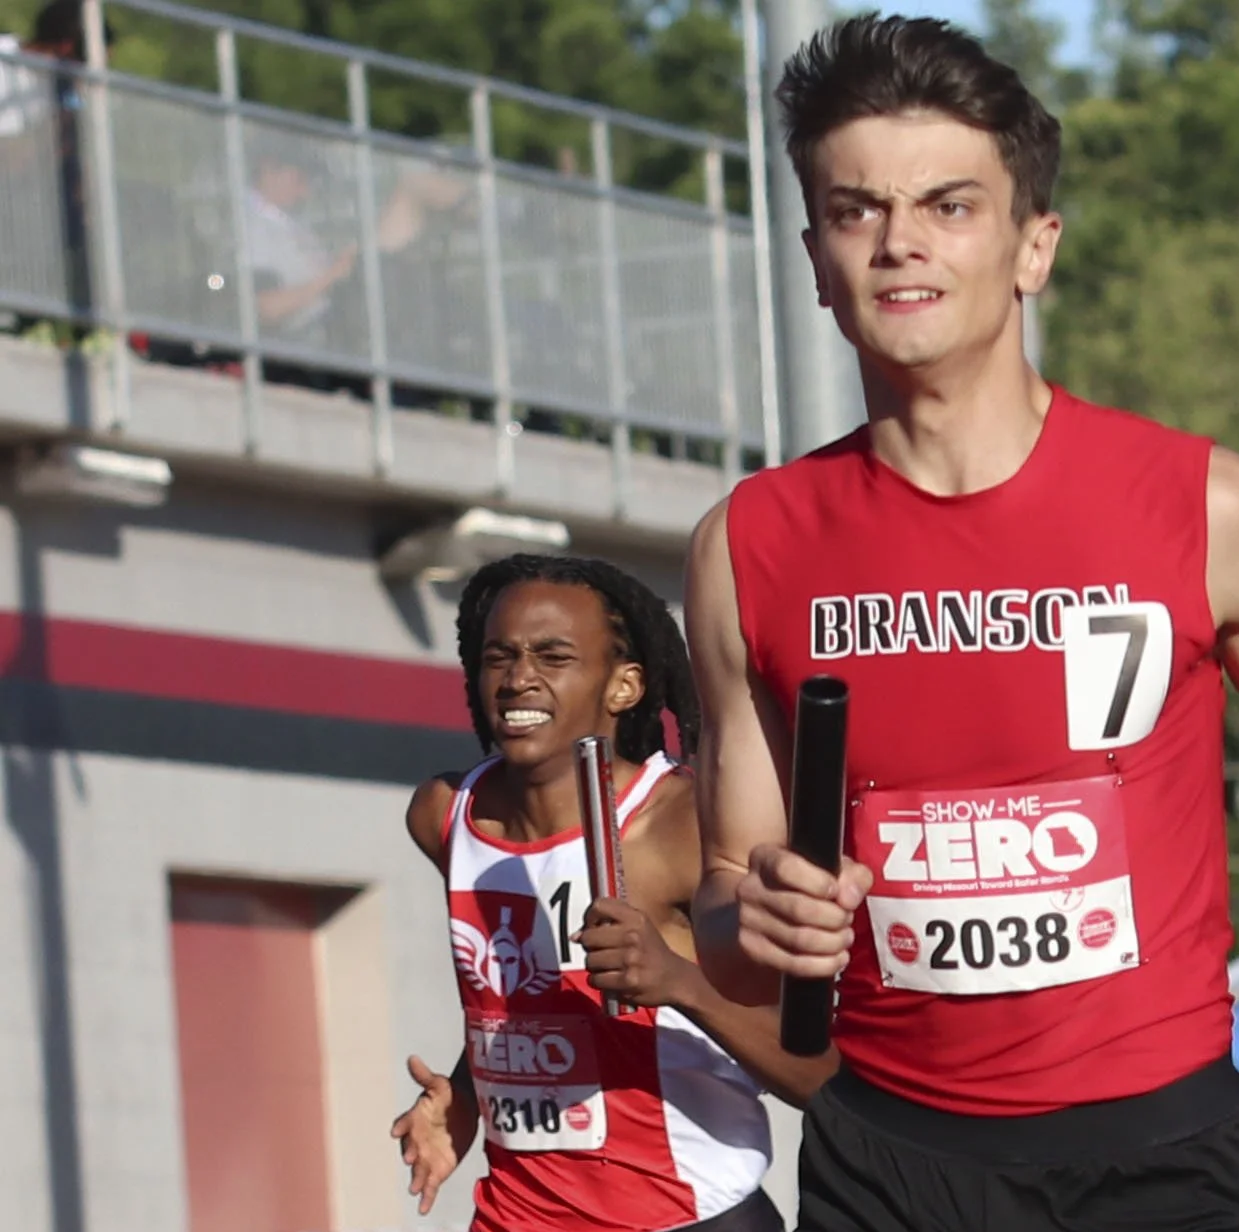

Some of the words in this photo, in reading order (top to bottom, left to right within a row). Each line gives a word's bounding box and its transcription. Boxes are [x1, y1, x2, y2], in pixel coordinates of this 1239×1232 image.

[1088, 614, 1148, 738] 7
[922, 795, 1041, 822] SHOW-ME
[878, 811, 1098, 881] ZERO
[550, 881, 571, 963] 1
[924, 911, 1071, 970] 2038
[469, 1029, 576, 1075] ZERO
[488, 1095, 560, 1134] 2310
